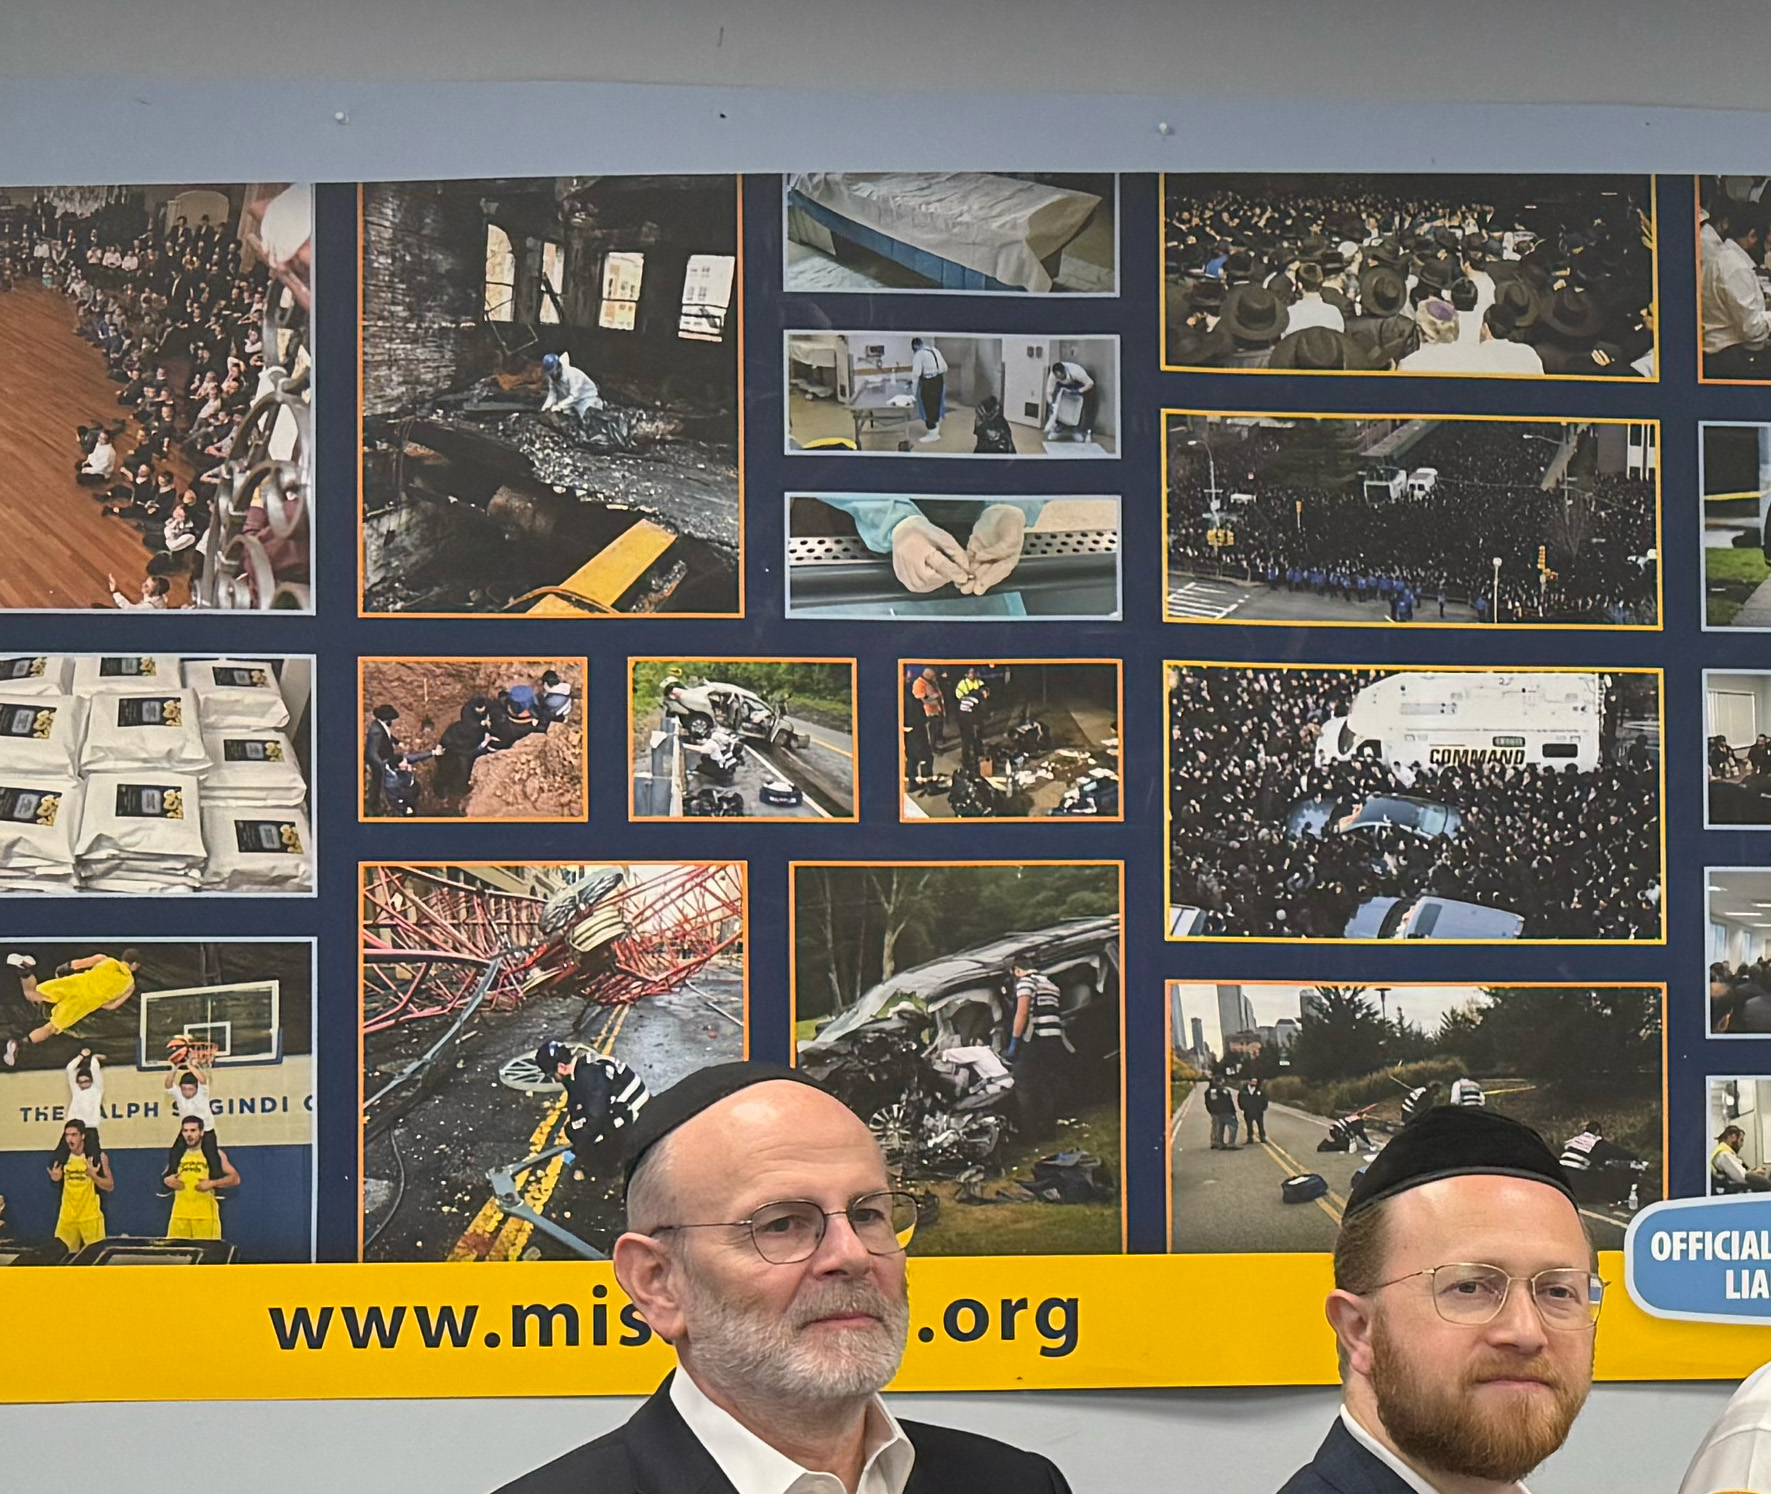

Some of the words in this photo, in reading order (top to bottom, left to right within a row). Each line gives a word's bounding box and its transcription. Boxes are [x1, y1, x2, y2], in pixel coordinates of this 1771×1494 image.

[1430, 749, 1525, 765] COMMAND
[20, 1106, 64, 1122] THE
[210, 1096, 288, 1115] GINDI
